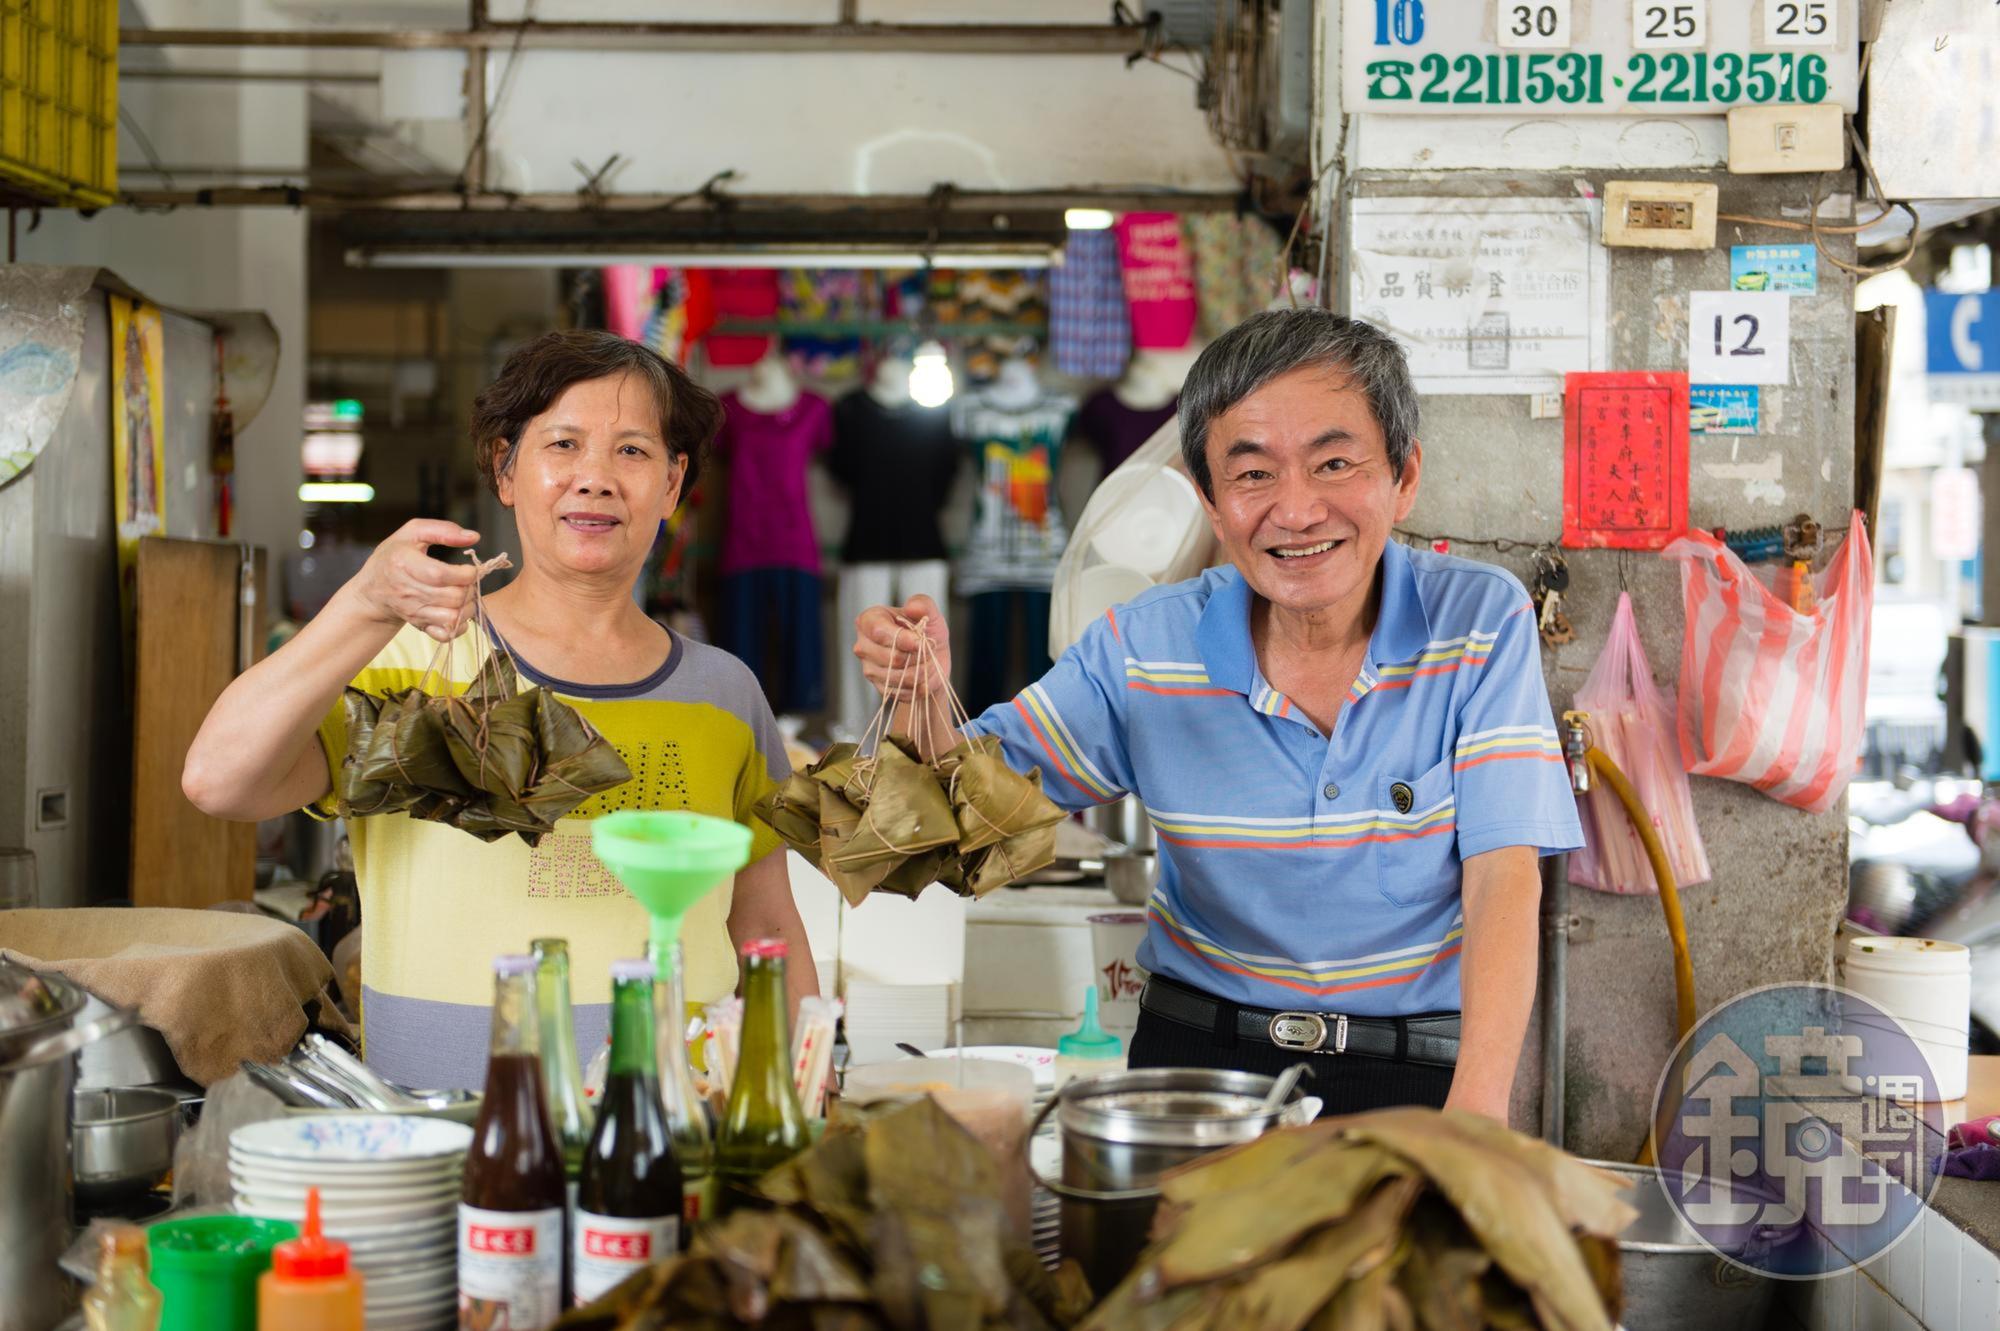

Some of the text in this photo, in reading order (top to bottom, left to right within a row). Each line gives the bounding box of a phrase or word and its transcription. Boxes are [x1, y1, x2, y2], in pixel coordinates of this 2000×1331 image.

[1511, 6, 1557, 37] 30
[1645, 7, 1696, 38] 25
[1776, 3, 1828, 34] 25
[1420, 52, 1827, 104] 2211531 2213516
[1715, 314, 1765, 356] 12
